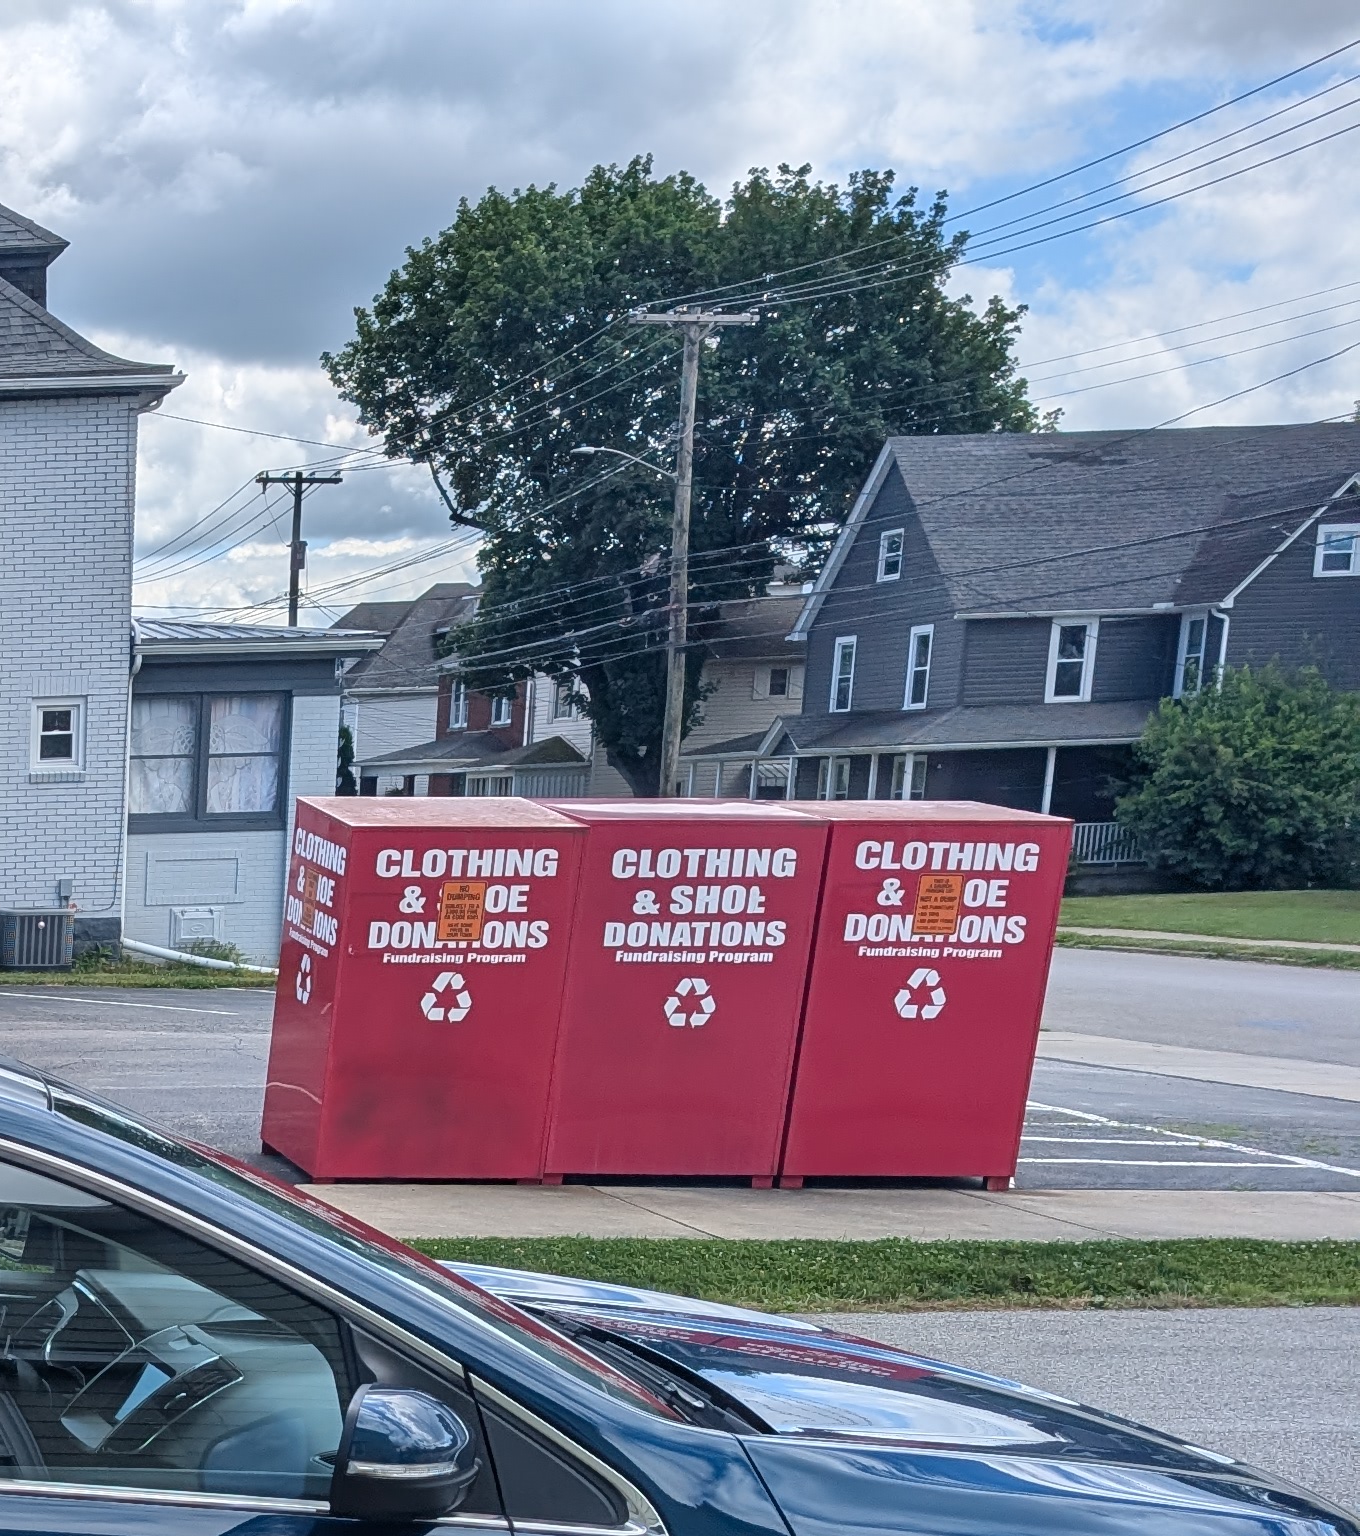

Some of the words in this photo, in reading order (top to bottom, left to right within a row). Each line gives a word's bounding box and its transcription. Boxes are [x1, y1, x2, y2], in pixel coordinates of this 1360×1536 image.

[294, 827, 347, 877] CLOTHING
[376, 848, 559, 878] CLOTHING
[611, 848, 797, 879] CLOTHING
[855, 840, 1040, 872] CLOTHING
[297, 865, 305, 893] &
[316, 873, 336, 908] OE
[399, 885, 427, 914] &
[437, 884, 530, 914] OE
[632, 889, 661, 915] &
[669, 884, 766, 915] SHOE
[876, 877, 906, 907] &
[367, 920, 550, 949] DONONS
[603, 920, 787, 947] DONATIONS
[382, 952, 464, 965] Fundraising
[467, 952, 527, 965] Program
[615, 950, 706, 964] Fundraising
[708, 950, 774, 964] Program
[858, 945, 940, 959] Fundraising
[942, 946, 1003, 959] Program
